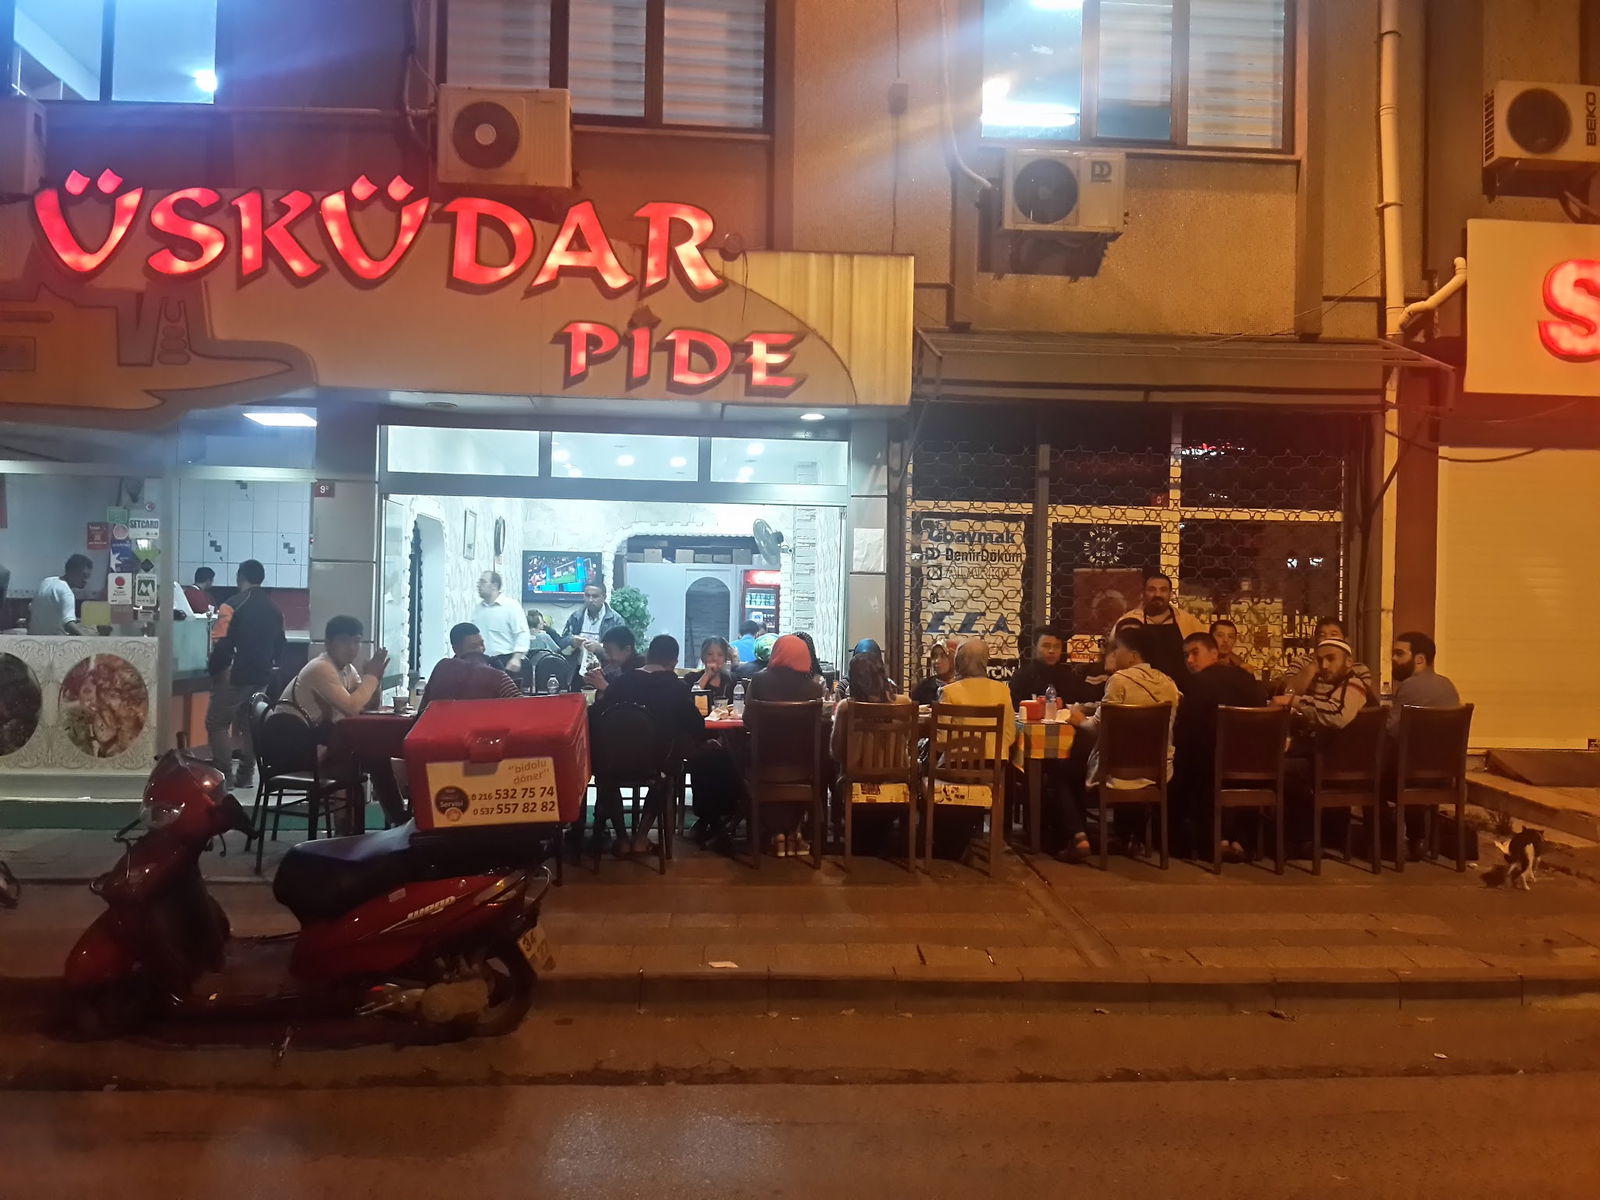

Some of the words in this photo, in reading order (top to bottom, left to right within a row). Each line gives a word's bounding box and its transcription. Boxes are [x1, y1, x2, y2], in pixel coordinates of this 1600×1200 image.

[1585, 91, 1597, 146] BEKO
[34, 168, 724, 292] ÜSKÜDAR
[130, 519, 159, 529] SETCARD
[943, 528, 1015, 546] baymak
[478, 792, 493, 801] 216
[494, 788, 517, 800] 532
[521, 787, 536, 799] 75
[540, 786, 554, 798] 74
[480, 807, 495, 816] 537
[496, 802, 519, 815] 557
[522, 801, 537, 814] 82
[541, 800, 556, 813] 82
